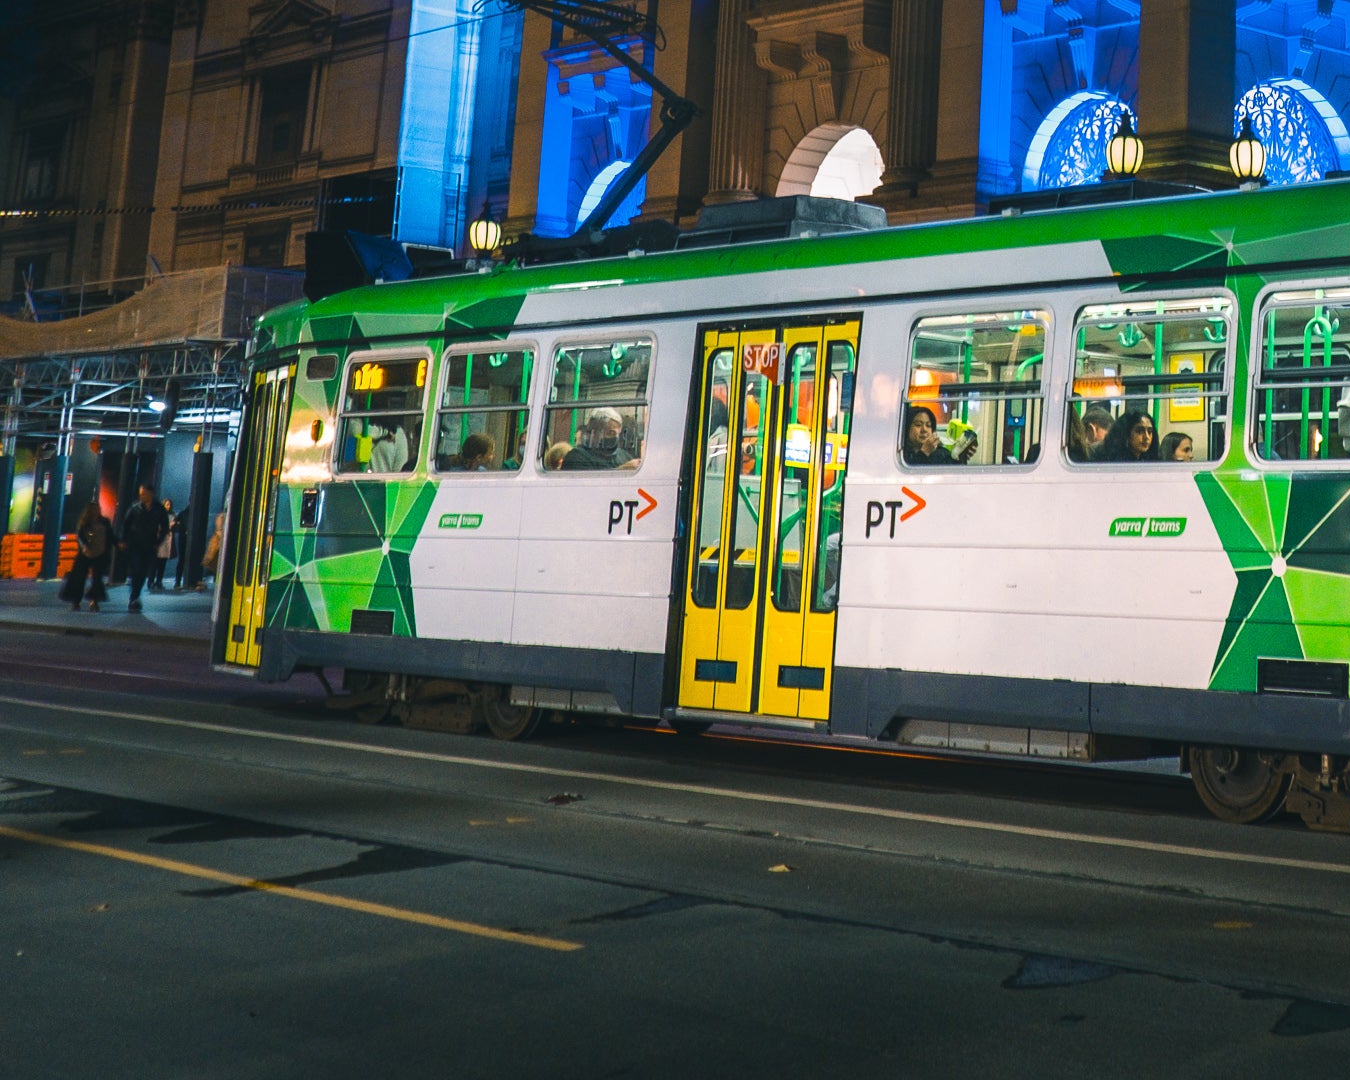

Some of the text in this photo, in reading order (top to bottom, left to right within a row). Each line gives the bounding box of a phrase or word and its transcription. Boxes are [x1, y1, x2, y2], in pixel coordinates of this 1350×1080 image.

[744, 345, 779, 369] STOP
[1115, 520, 1180, 535] yarra trams
